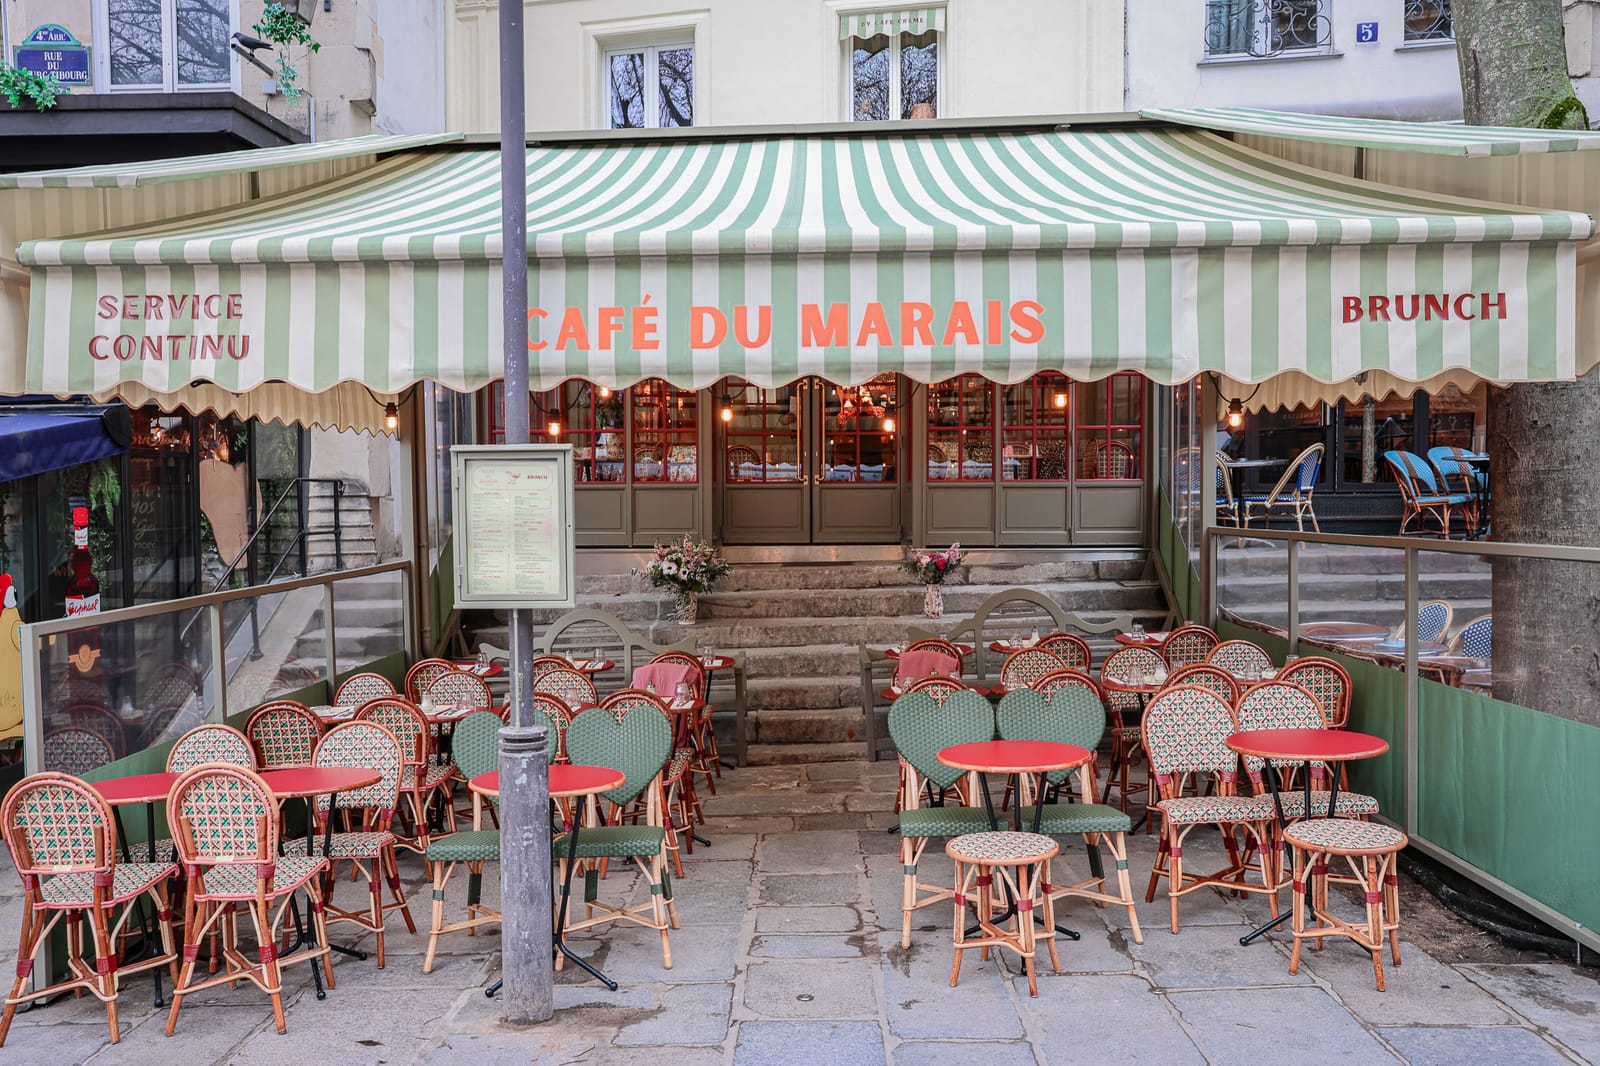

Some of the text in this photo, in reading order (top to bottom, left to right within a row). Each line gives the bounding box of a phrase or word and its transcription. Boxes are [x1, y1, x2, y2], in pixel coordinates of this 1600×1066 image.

[1361, 23, 1373, 41] 5
[44, 51, 63, 61] RUE
[47, 61, 60, 70] DU
[97, 294, 243, 320] SERVICE
[1342, 292, 1507, 324] BRUNCH
[690, 305, 772, 350] DU
[801, 300, 1046, 348] MARAIS
[88, 334, 250, 361] CONTINU
